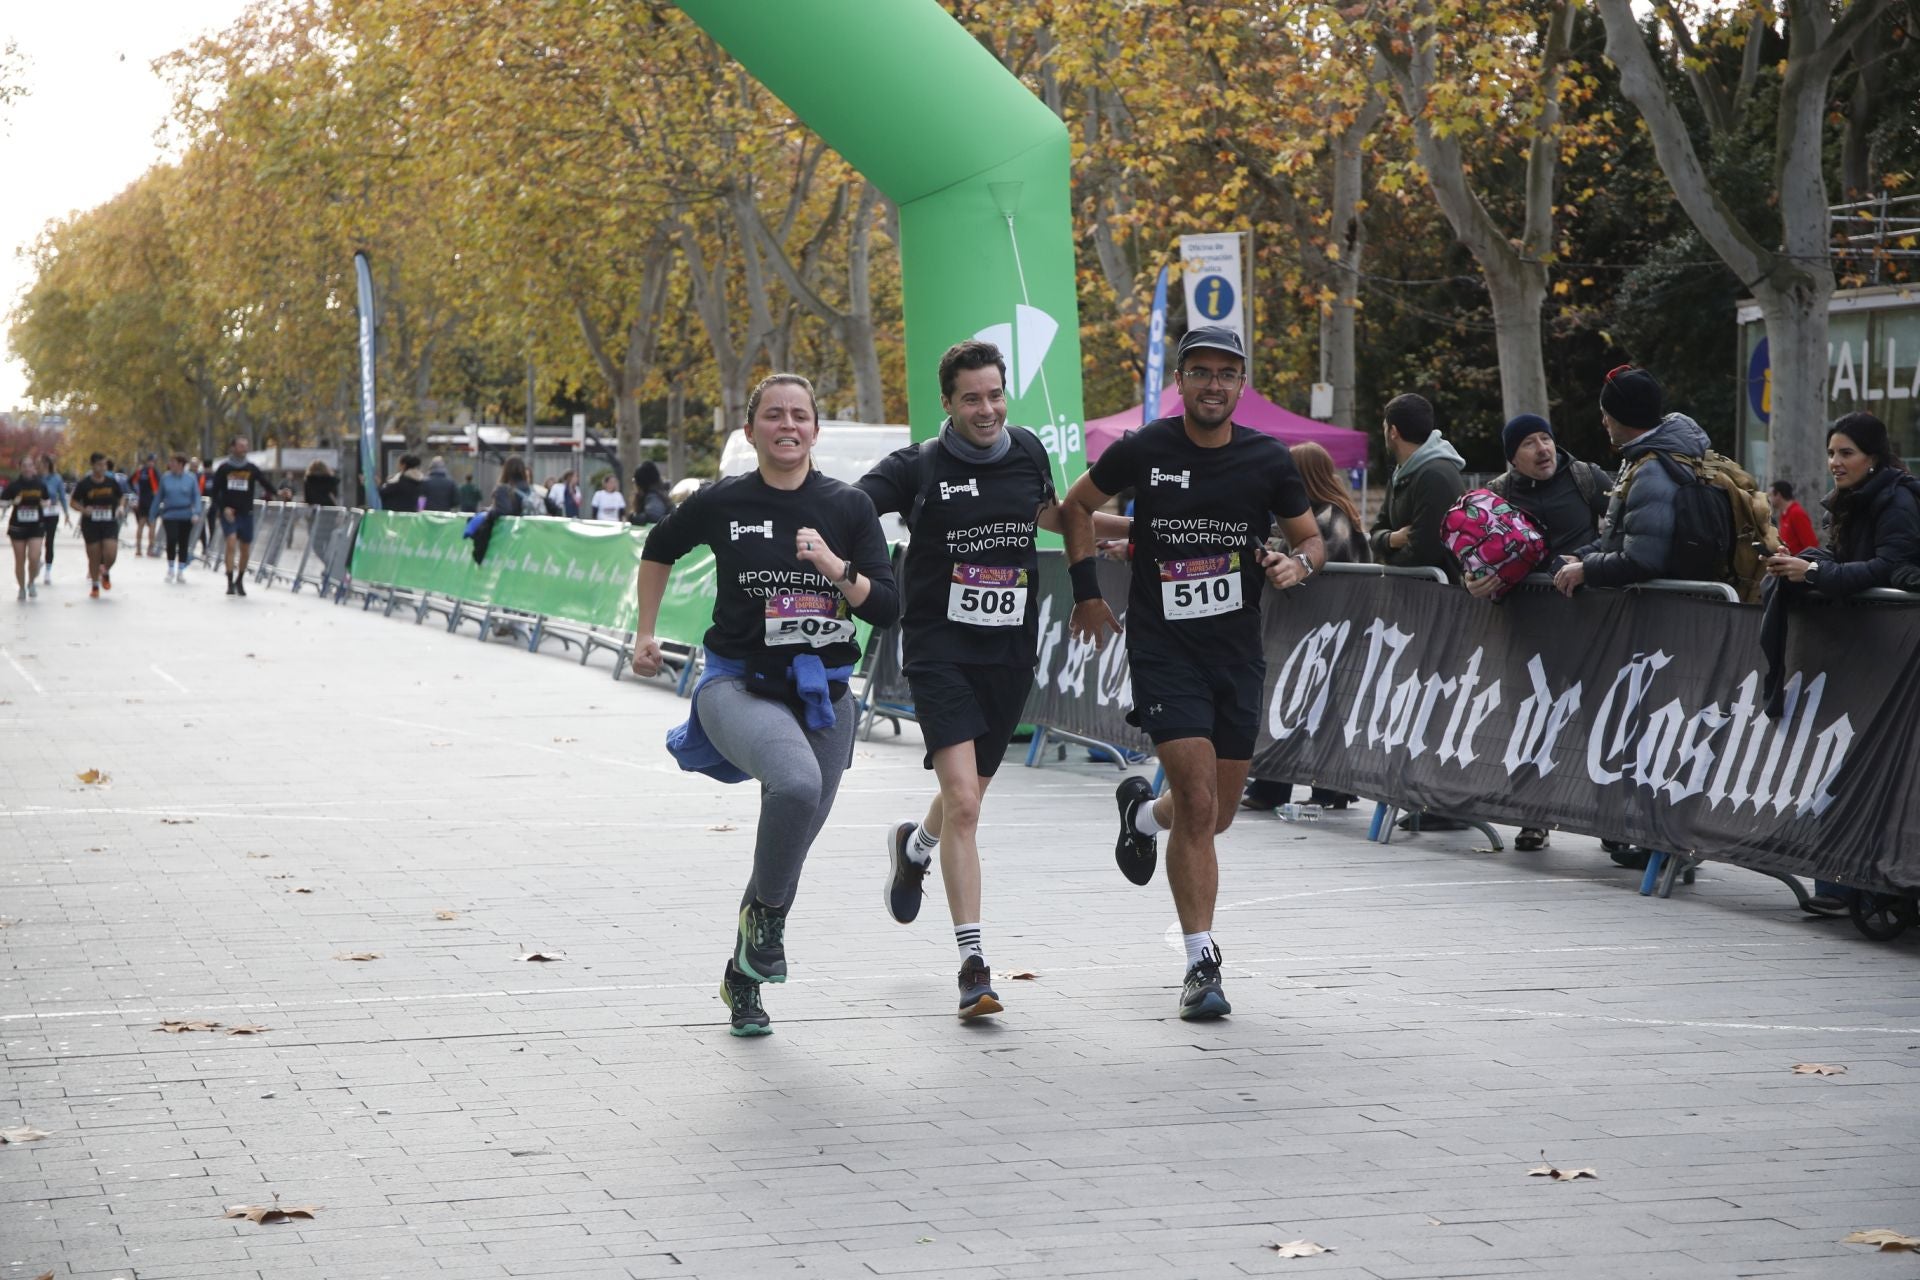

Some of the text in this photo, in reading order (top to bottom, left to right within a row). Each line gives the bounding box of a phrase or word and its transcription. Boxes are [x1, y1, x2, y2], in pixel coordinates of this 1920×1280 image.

[1828, 337, 1920, 401] ALL
[1022, 414, 1081, 464] aja
[1150, 467, 1190, 489] HORSE
[939, 478, 980, 500] HORSE
[730, 520, 773, 541] HORSE
[946, 522, 1034, 541] #POWERING
[1151, 517, 1248, 532] #POWERING
[947, 536, 1029, 553] TOMORRO
[1153, 531, 1247, 547] TOMORROW
[738, 570, 834, 587] #POWERIN
[960, 588, 1015, 614] 508
[1175, 578, 1230, 607] 510
[779, 618, 841, 636] 509
[1269, 620, 1350, 739] El
[1344, 617, 1500, 770] Norte
[1502, 653, 1581, 779] de
[1587, 648, 1856, 819] Castilla
